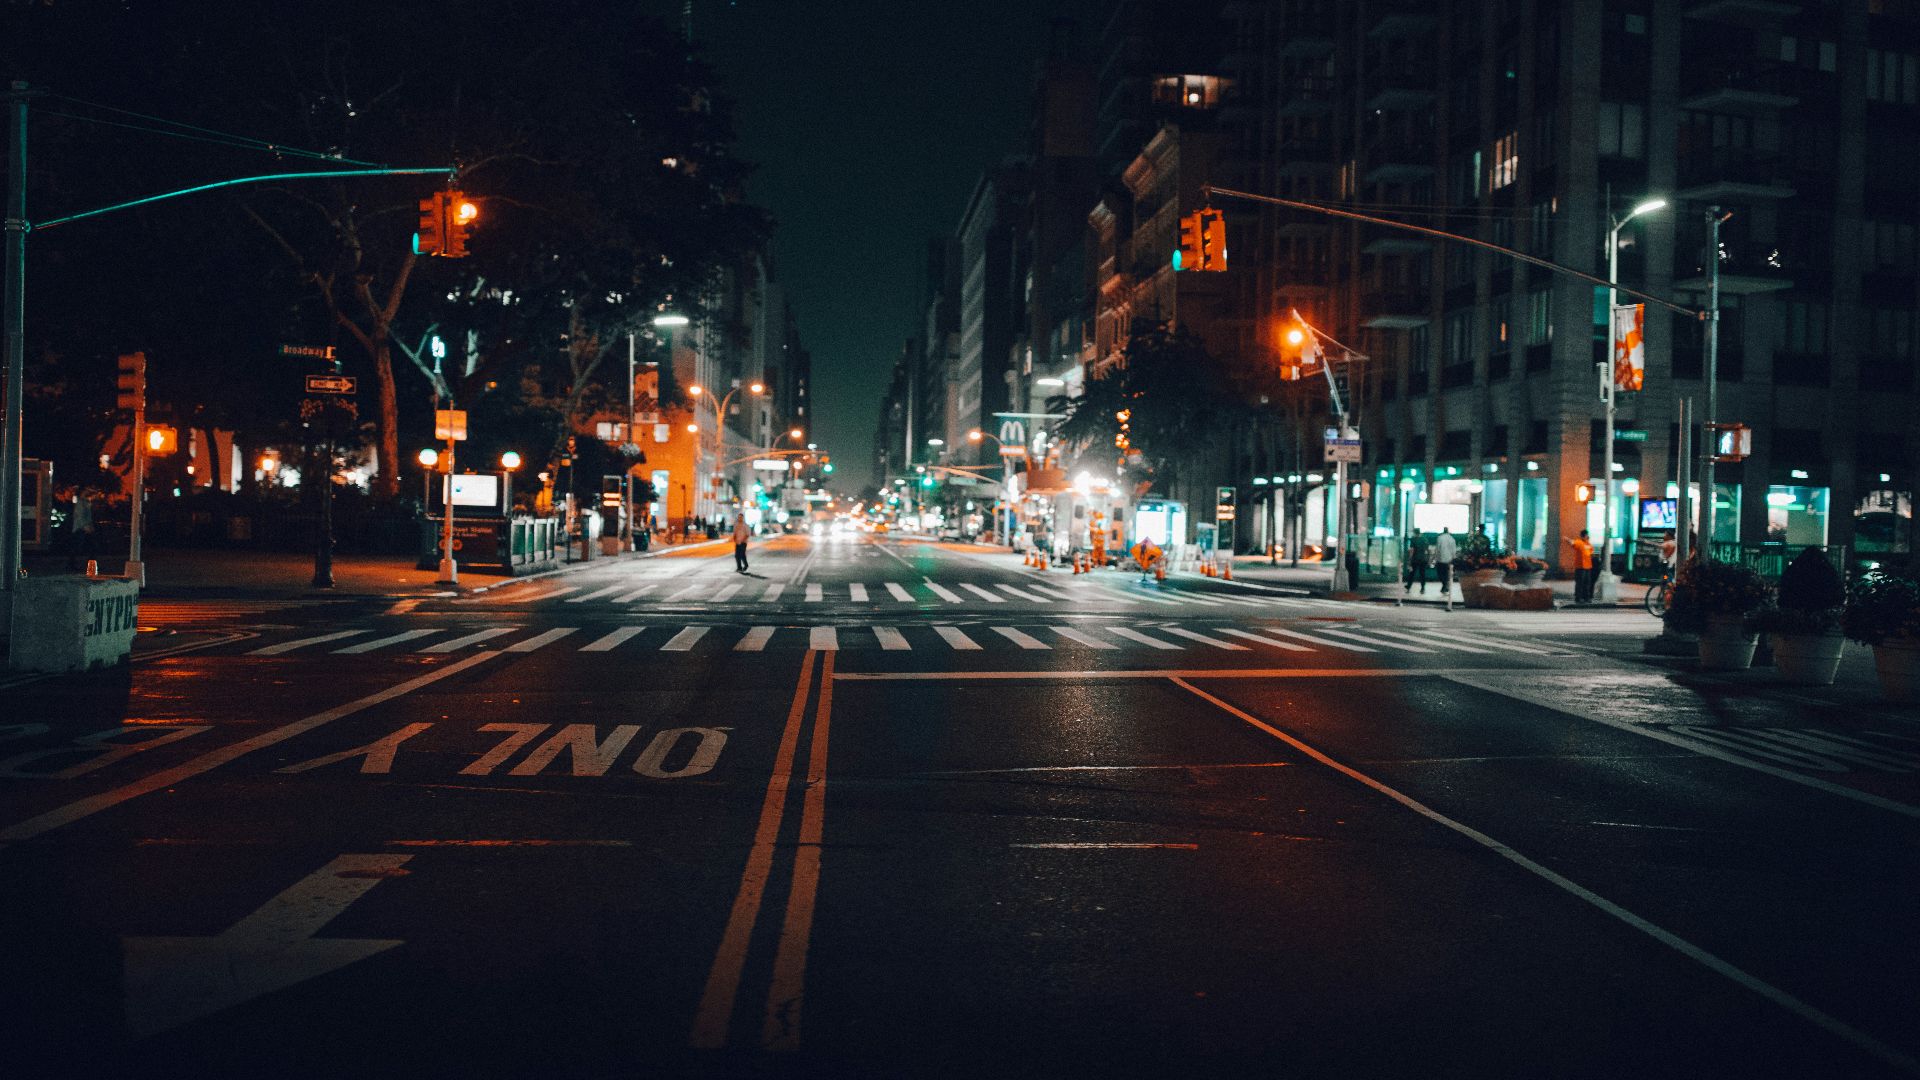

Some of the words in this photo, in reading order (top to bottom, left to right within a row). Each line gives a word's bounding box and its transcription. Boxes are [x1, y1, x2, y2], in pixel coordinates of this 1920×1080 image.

[283, 344, 324, 358] Broadway
[93, 594, 133, 636] NYPD
[277, 722, 732, 780] ONLY
